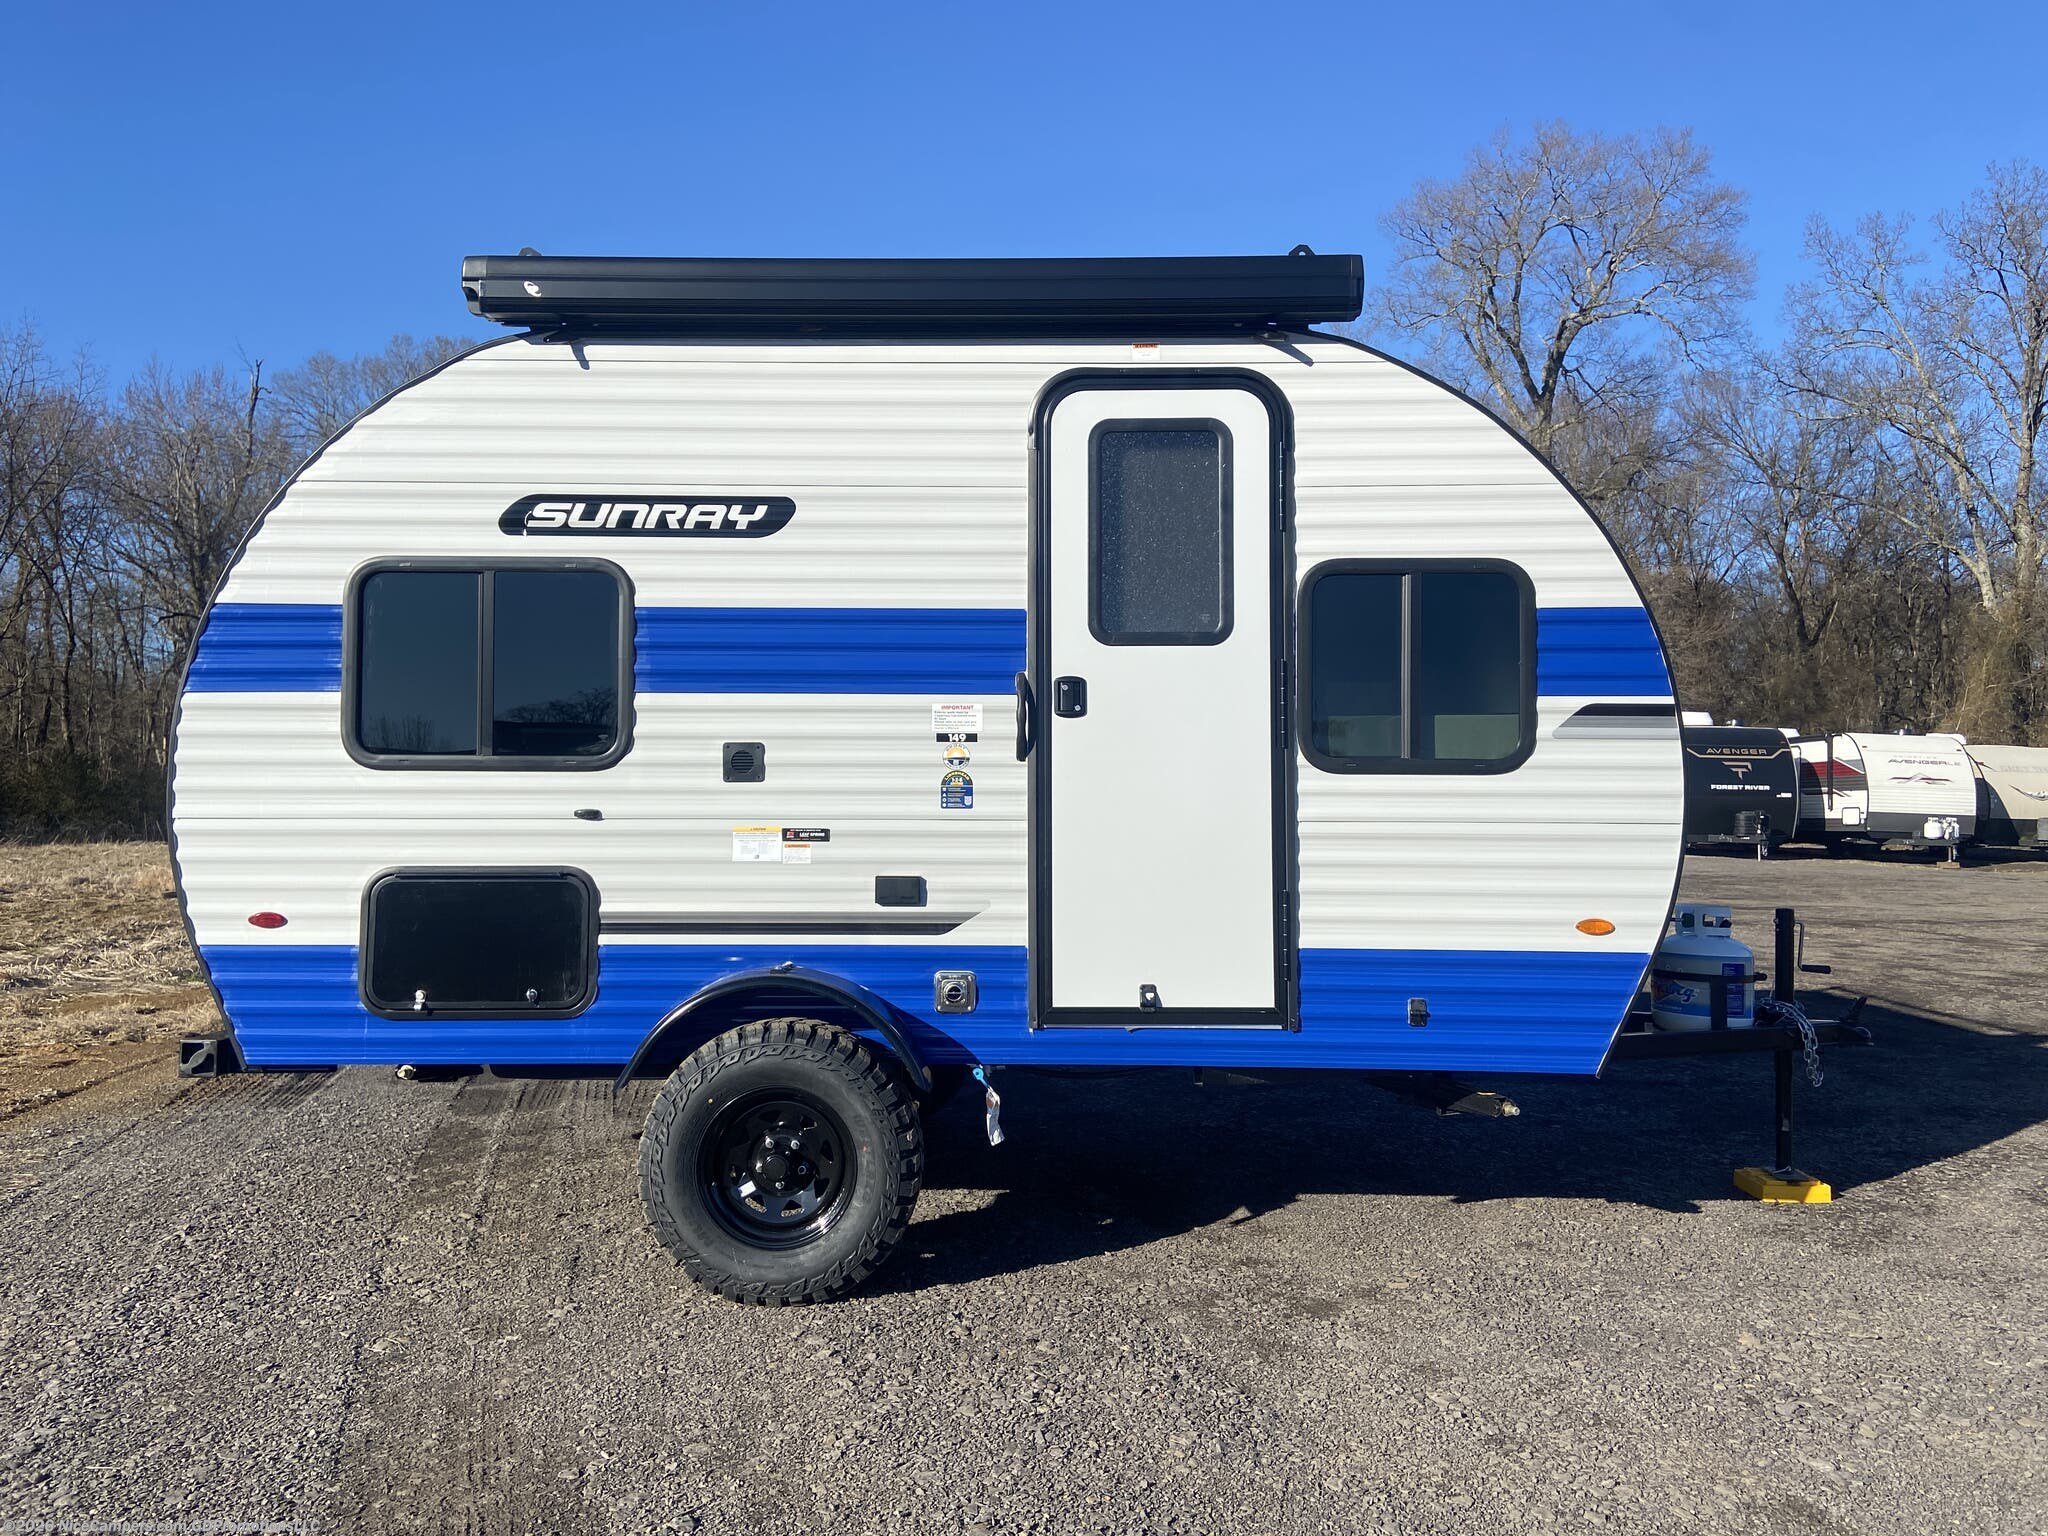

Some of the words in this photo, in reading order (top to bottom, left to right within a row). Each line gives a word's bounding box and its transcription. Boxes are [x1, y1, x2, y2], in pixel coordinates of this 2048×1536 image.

[527, 502, 769, 530] SUNRAY
[948, 733, 966, 742] 149
[1706, 747, 1767, 755] AVENGER
[1888, 758, 1947, 766] AVENGER
